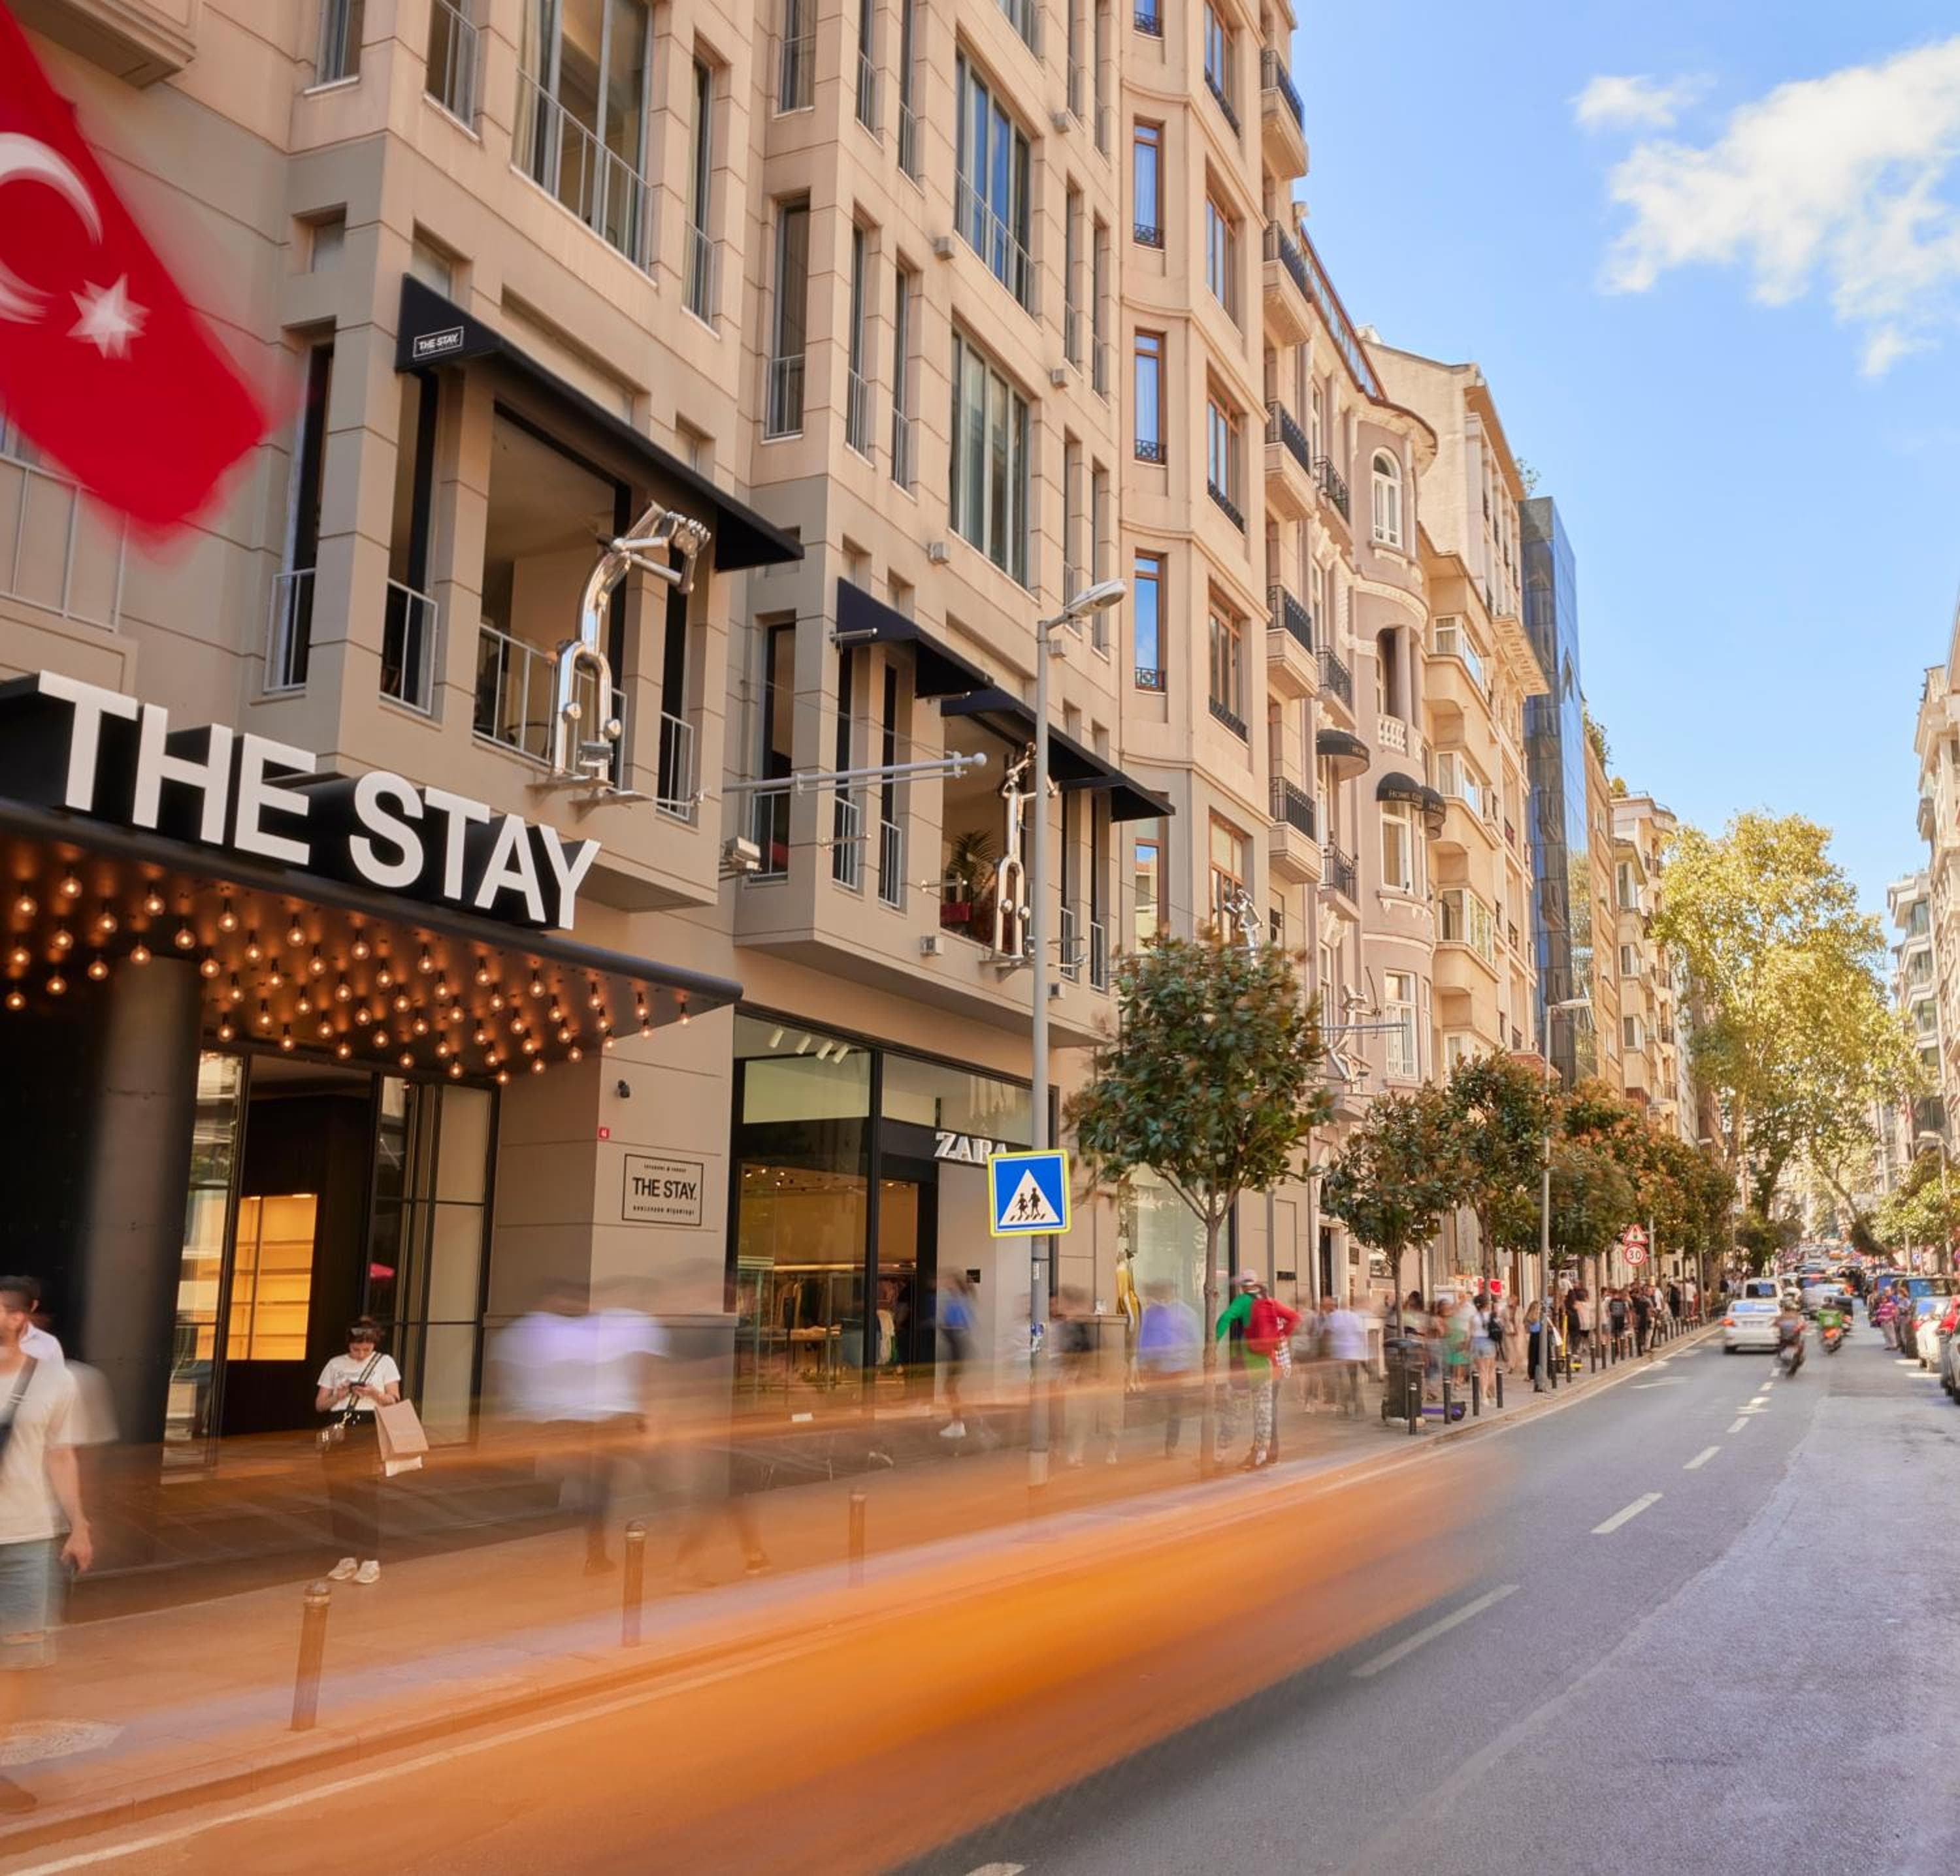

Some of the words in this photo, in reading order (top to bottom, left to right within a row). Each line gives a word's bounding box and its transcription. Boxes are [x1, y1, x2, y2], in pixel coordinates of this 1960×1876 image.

[419, 339, 436, 349] THE
[38, 669, 317, 865] THE
[350, 771, 602, 931] STAY
[632, 1176, 661, 1197] THE
[1629, 1250, 1642, 1260] 30
